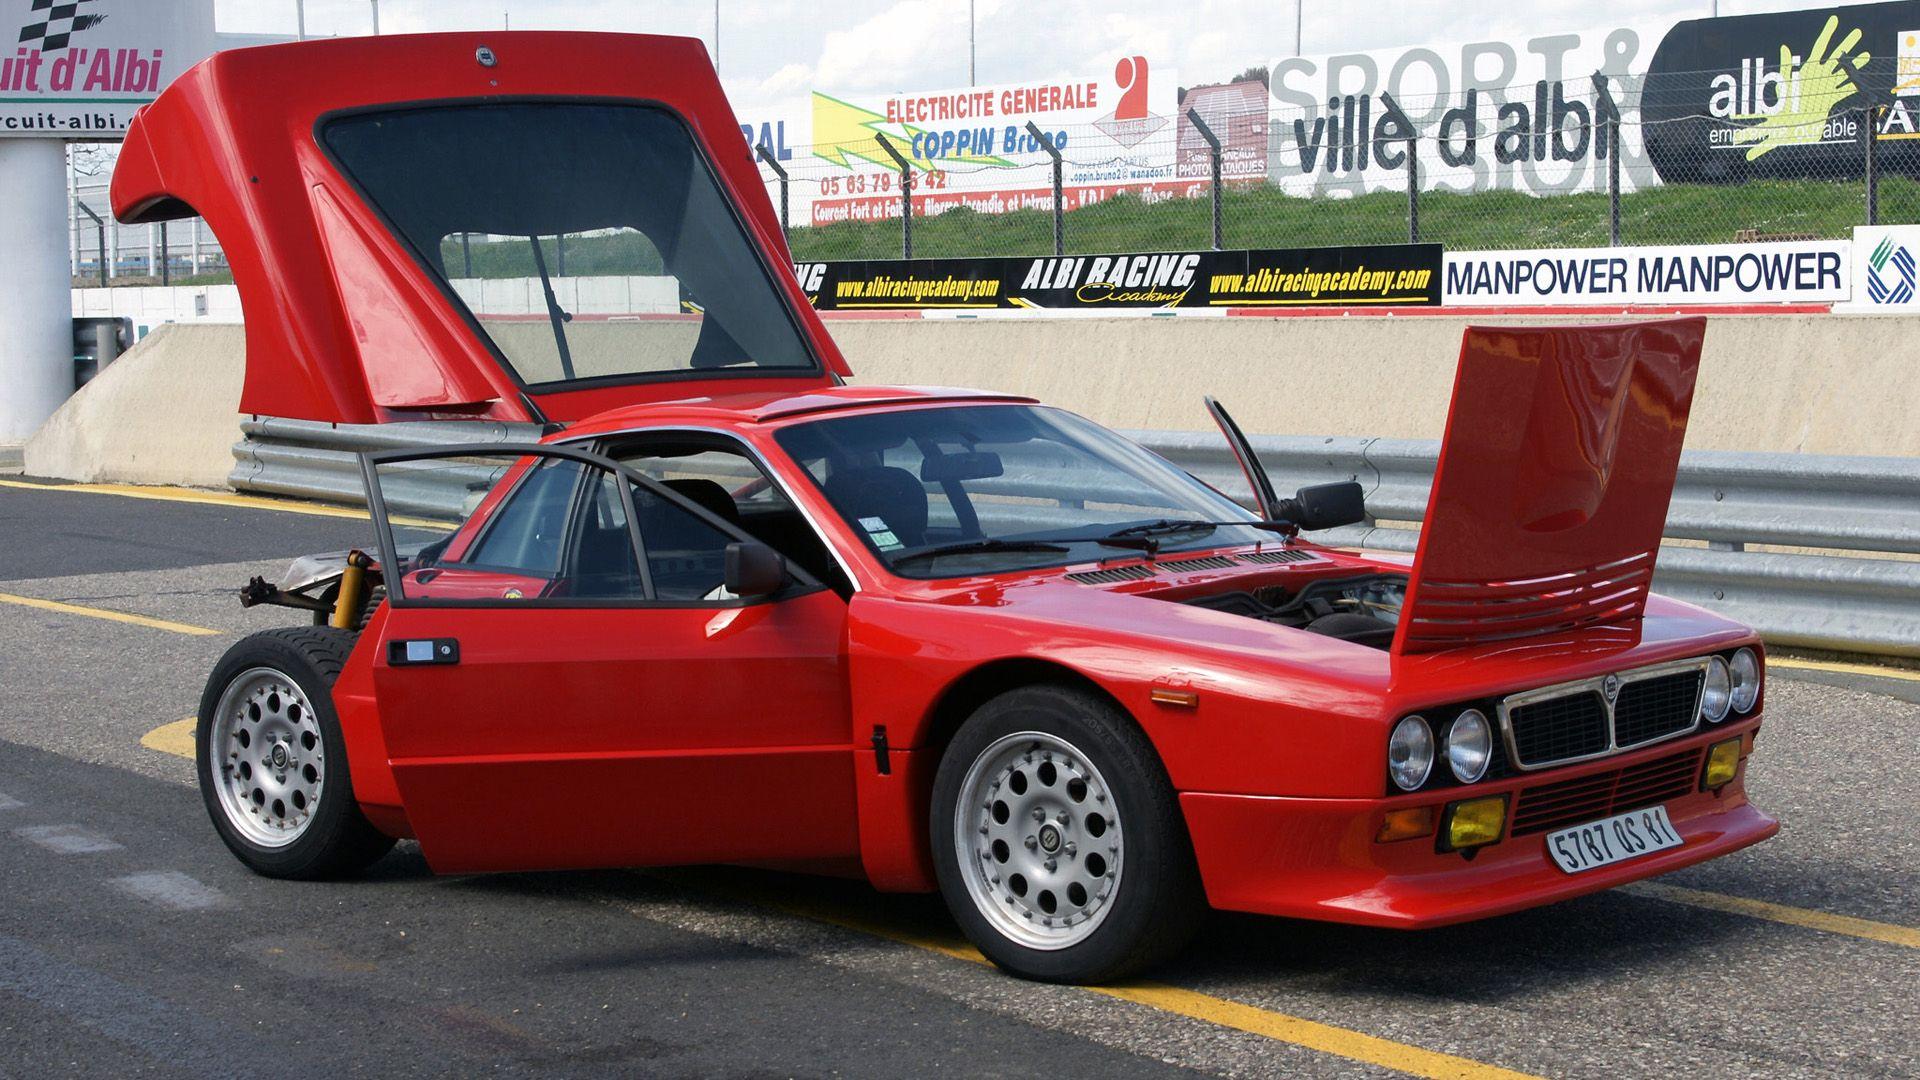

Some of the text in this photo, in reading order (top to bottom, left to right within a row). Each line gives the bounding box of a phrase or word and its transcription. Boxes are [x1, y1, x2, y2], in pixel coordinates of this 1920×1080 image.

[50, 47, 163, 92] d'Albi
[1270, 34, 1581, 129] SPORT
[1709, 55, 1801, 118] albi
[0, 112, 132, 129] cuit-albi.
[1294, 94, 1406, 173] ville
[911, 127, 995, 159] COPPIN
[821, 176, 840, 195] 05
[846, 174, 866, 194] 63
[872, 172, 891, 192] 79
[925, 169, 946, 189] 42
[836, 274, 1000, 302] www.albiracingacademy.com
[1021, 254, 1201, 290] ALBI RACING
[1209, 266, 1432, 297] www.albiracingacademy.com
[1447, 252, 1842, 295] MANPOWER MANPOWER
[1554, 824, 1614, 868] 5787
[1642, 809, 1675, 845] 81
